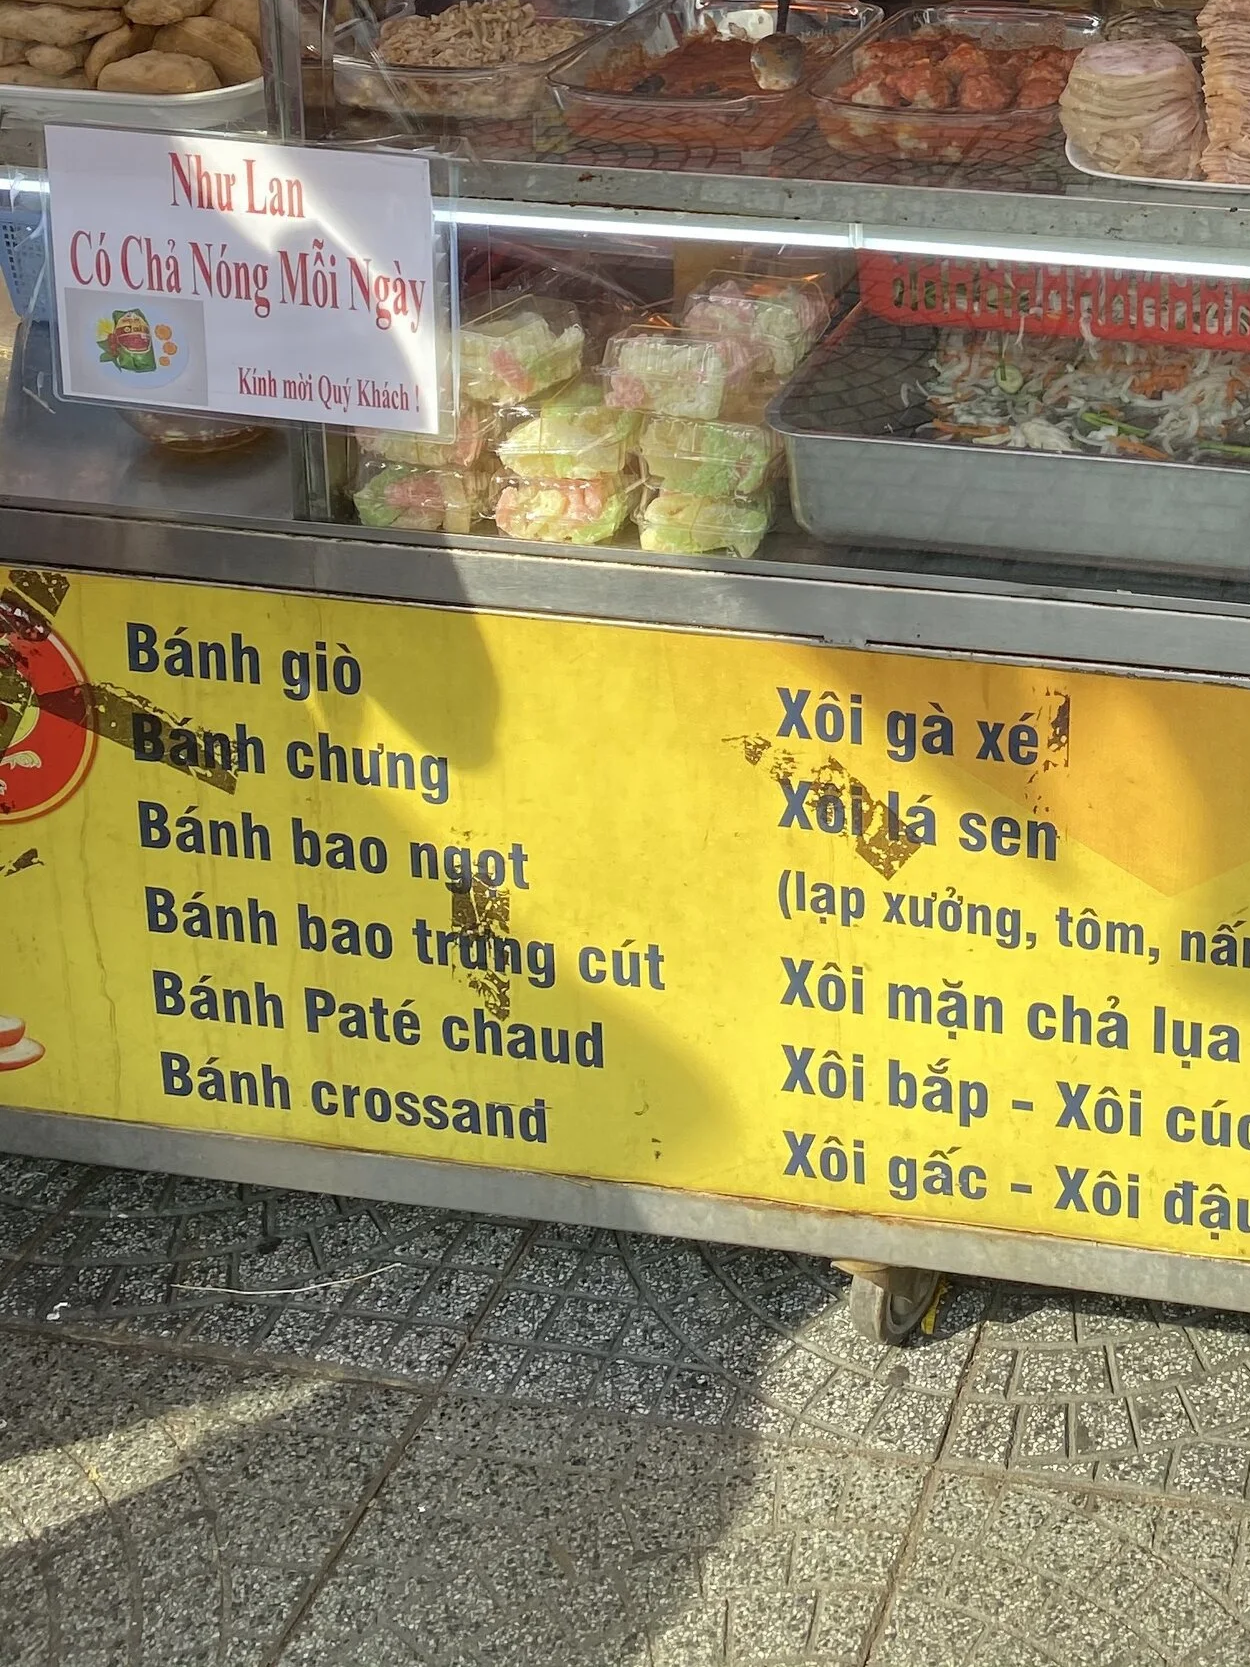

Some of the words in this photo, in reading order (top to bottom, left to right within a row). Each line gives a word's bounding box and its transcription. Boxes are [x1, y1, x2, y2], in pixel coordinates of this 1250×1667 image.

[169, 152, 235, 212] Như
[243, 159, 305, 218] Lan
[69, 229, 111, 286] Có
[120, 234, 182, 294] Chả
[189, 241, 271, 319] Nóng
[278, 238, 341, 310] Mỗi
[347, 256, 426, 333] Ngày
[237, 366, 277, 398] Kính
[283, 373, 313, 402] mời
[318, 376, 352, 413] Quý
[357, 378, 409, 411] Khách
[125, 621, 262, 684] Bánh
[281, 638, 362, 701] giò
[130, 711, 265, 774] Bánh
[286, 728, 450, 805] chưng
[775, 686, 863, 744] Xôi
[885, 703, 955, 763] gà
[975, 711, 1040, 767] xé
[137, 799, 271, 862] Bánh
[291, 817, 388, 875] bao
[409, 841, 531, 898] ngọt
[776, 780, 864, 834] Xôi
[888, 790, 938, 847] lá
[958, 811, 1059, 862] sen
[144, 886, 278, 947] Bánh
[297, 904, 394, 960] bao
[577, 938, 666, 990] cút
[778, 869, 867, 926] (lạp
[881, 887, 1038, 950] xưởng,
[1056, 908, 1161, 965] tôm,
[152, 969, 285, 1029] Bánh
[304, 987, 422, 1048] Paté
[442, 1007, 605, 1069] chaud
[779, 957, 864, 1015] Xôi
[887, 978, 1005, 1041] mặn
[1026, 995, 1129, 1051] chả
[1153, 1007, 1242, 1070] lụa
[160, 1050, 291, 1111] Bánh
[310, 1077, 548, 1145] crossand
[780, 1045, 866, 1103] Xôi
[888, 1057, 990, 1126] bắp
[1055, 1082, 1144, 1137] Xôi
[782, 1130, 867, 1185] Xôi
[888, 1149, 988, 1202] gấc
[1055, 1165, 1141, 1219] Xôi
